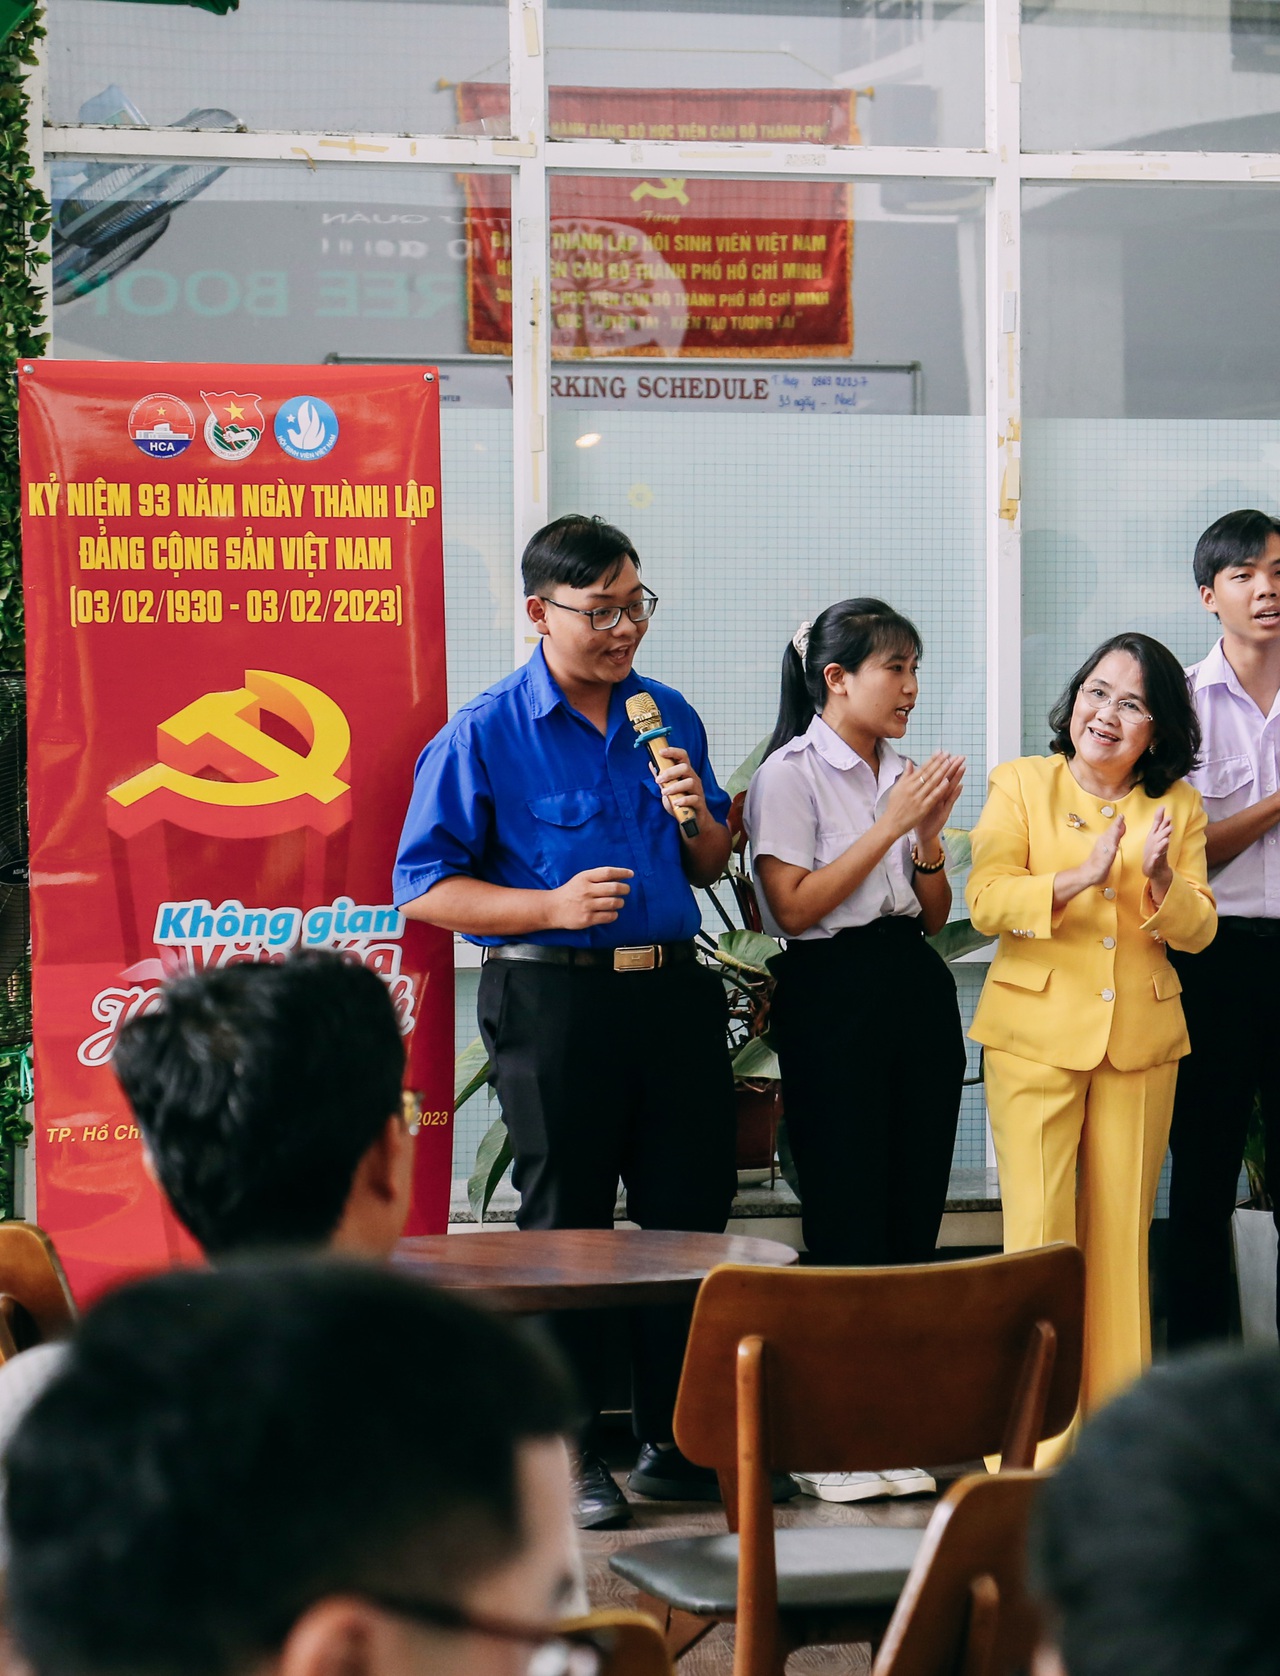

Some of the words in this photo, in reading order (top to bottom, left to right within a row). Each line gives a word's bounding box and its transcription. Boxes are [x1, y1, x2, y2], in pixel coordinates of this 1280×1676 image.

[674, 235, 712, 252] SINH
[716, 232, 751, 252] VIÊN
[755, 232, 788, 255] VIỆT
[793, 234, 827, 251] NAM
[691, 258, 722, 280] PHỐ
[727, 257, 748, 280] HỒ
[752, 260, 778, 280] CHÍ
[783, 262, 823, 280] MINH
[795, 291, 830, 306] MINH
[637, 375, 769, 400] SCHEDULE
[149, 441, 175, 452] HCA
[28, 472, 60, 517] KỶ
[67, 477, 131, 525] NIỆM
[138, 483, 170, 517] 93
[177, 477, 235, 518] NĂM
[242, 478, 305, 518] NGÀY
[311, 478, 389, 518] THÀNH
[395, 479, 436, 526] LẬP
[79, 525, 146, 571] ĐẢNG
[151, 530, 219, 578] CỘNG
[225, 526, 274, 571] SẢN
[281, 531, 329, 578] VIỆT
[335, 537, 392, 570] NAM
[229, 603, 240, 611] -
[158, 904, 295, 945] Không
[306, 901, 399, 945] gian
[46, 1127, 76, 1144] TP.
[82, 1123, 109, 1142] Hồ
[115, 1124, 143, 1142] Ch
[416, 1111, 449, 1126] 2023
